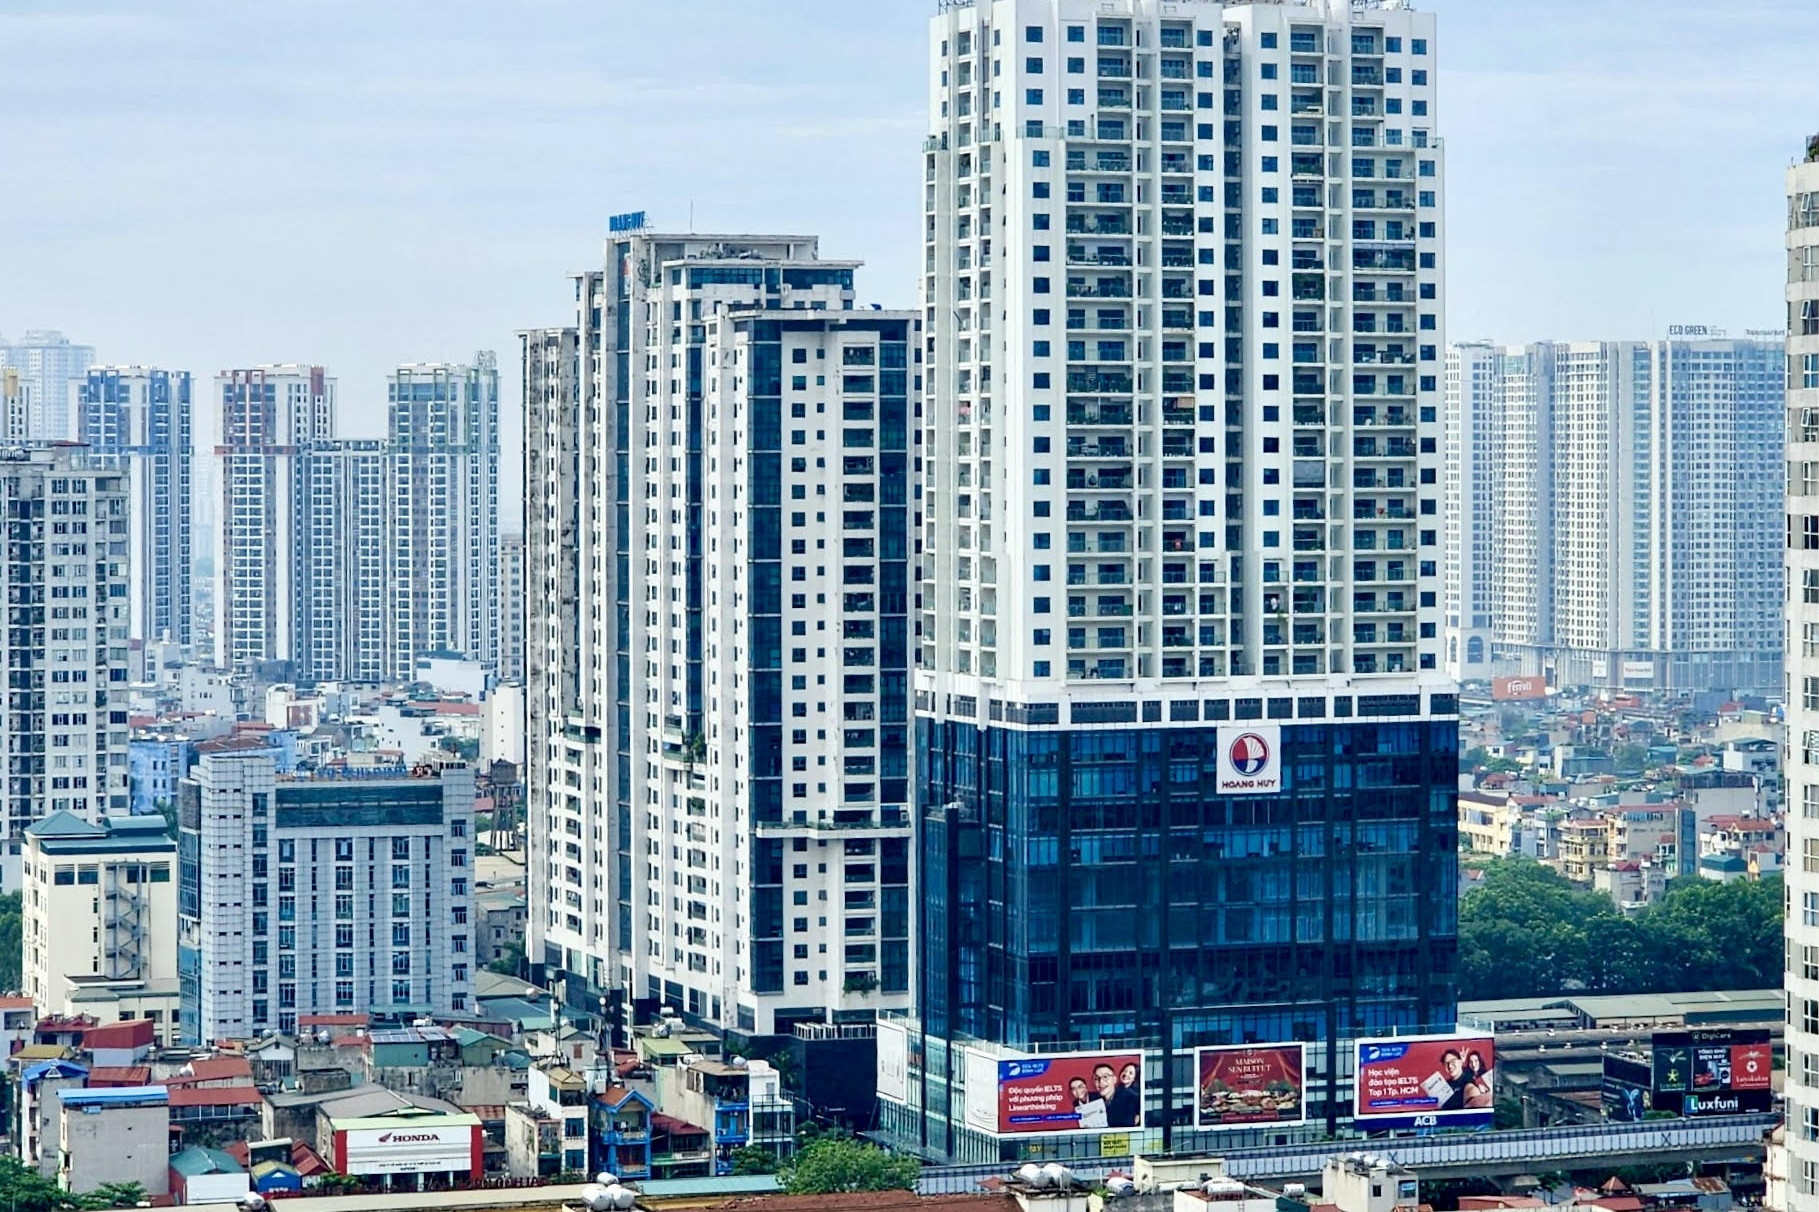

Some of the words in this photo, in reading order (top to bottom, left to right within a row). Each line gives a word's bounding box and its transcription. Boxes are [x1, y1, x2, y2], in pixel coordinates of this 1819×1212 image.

[1684, 325, 1708, 335] GREEN
[1257, 779, 1276, 787] HUY
[1397, 1077, 1419, 1085] IELTS
[1044, 1084, 1063, 1092] IELTS
[1369, 1088, 1382, 1098] Top
[1383, 1087, 1388, 1096] 1
[1388, 1087, 1399, 1097] Tp.
[1399, 1086, 1419, 1095] HCM
[1008, 1103, 1057, 1112] Linearthinking
[1691, 1096, 1739, 1111] Luxfuni
[1414, 1115, 1438, 1126] ACB
[392, 1134, 440, 1143] HONDA
